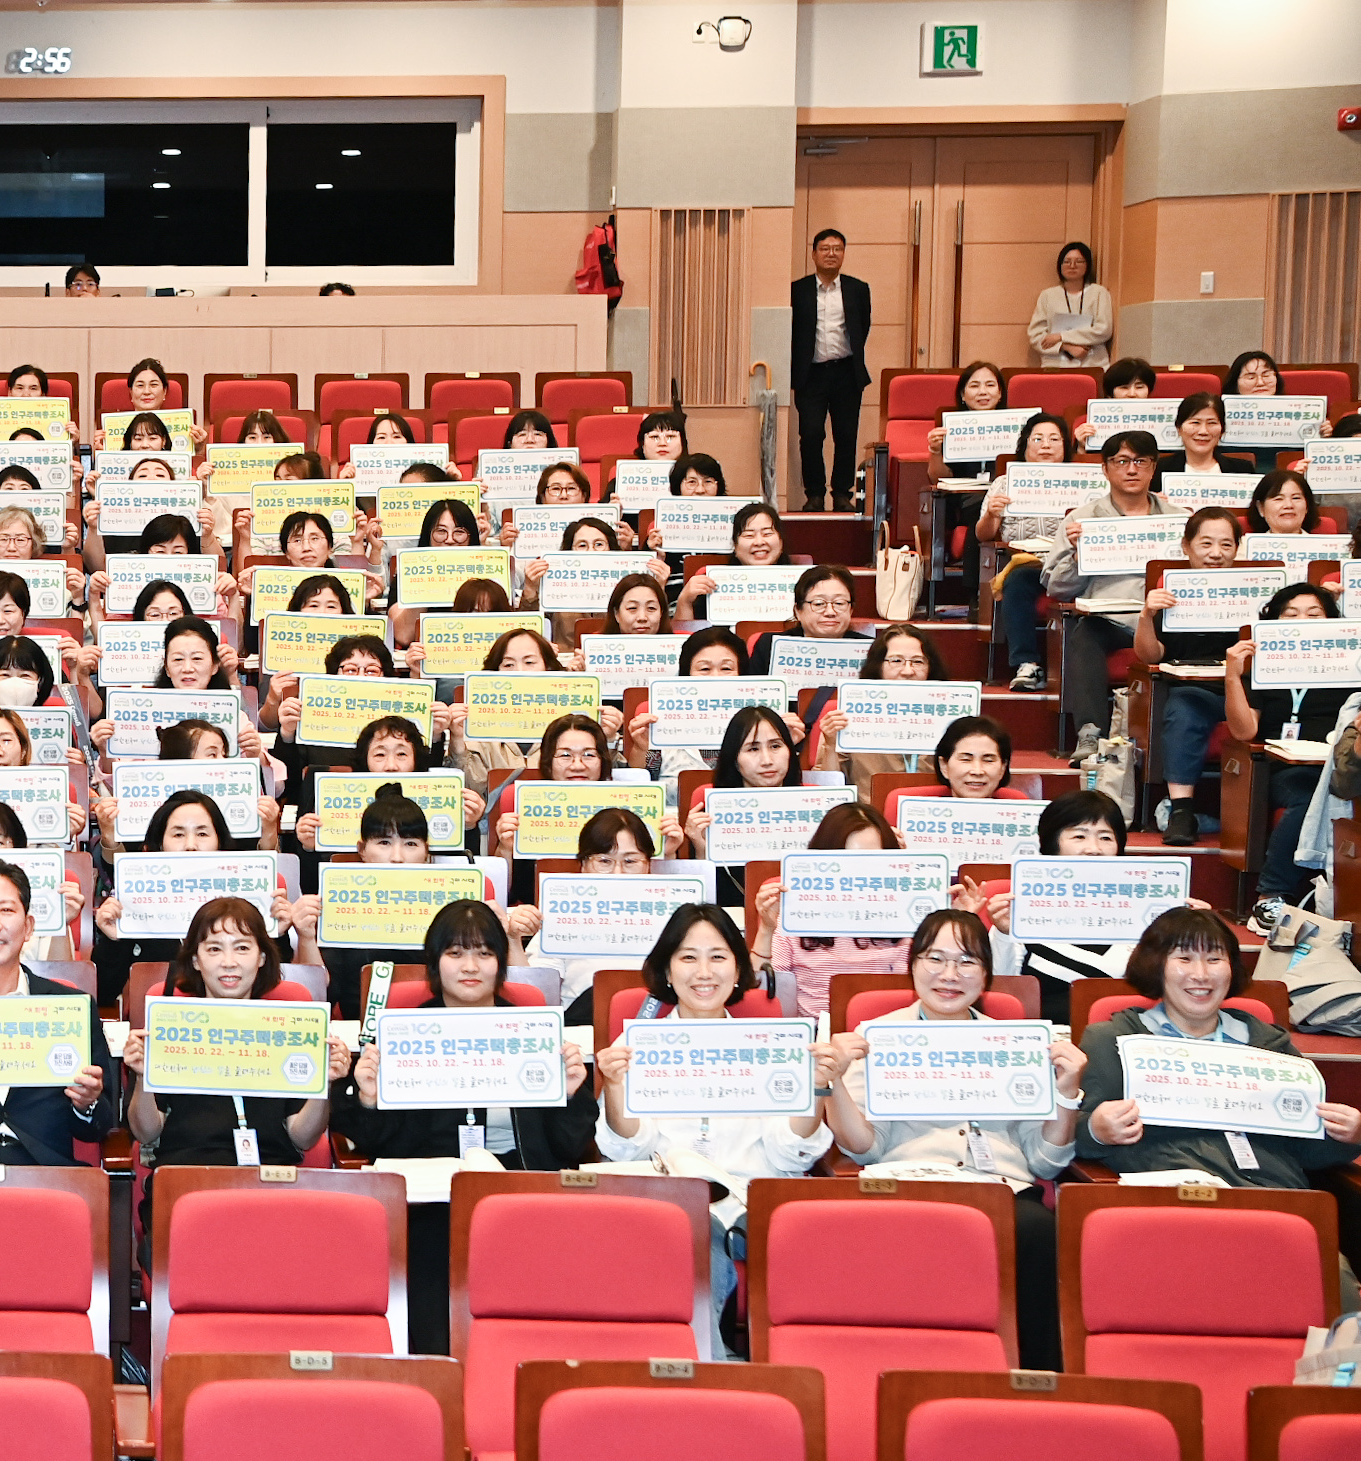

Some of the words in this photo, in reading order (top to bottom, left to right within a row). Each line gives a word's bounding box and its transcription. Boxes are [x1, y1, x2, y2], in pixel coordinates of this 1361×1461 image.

[20, 47, 71, 72] 2:56
[11, 411, 64, 419] 인구주택총조사
[1257, 411, 1320, 420] 인구주택총조사
[950, 427, 974, 435] 2025
[1312, 456, 1340, 464] 2025
[1013, 479, 1040, 487] 2025
[1044, 480, 1107, 489] 인구주택총조사
[103, 498, 130, 506] 2025
[133, 497, 196, 507] 인구주택총조사
[257, 498, 283, 507] 2025
[286, 497, 350, 507] 인구주택총조사
[661, 514, 689, 522] 2025
[1084, 535, 1113, 544] 2025
[404, 566, 433, 575] 2025
[547, 569, 576, 579] 2025
[113, 573, 141, 582] 2025
[1171, 589, 1203, 598] 2025
[1260, 641, 1296, 651] 2025
[62, 686, 74, 705] 2025
[472, 694, 507, 704] 2025
[511, 694, 593, 706] 인구주택총조사
[307, 696, 341, 708] 2025
[657, 699, 693, 710] 2025
[114, 710, 148, 721] 2025
[846, 703, 882, 714] 2025
[887, 703, 972, 717] 인구주택총조사
[524, 805, 561, 817] 2025
[715, 812, 753, 824] 2025
[907, 820, 946, 833] 2025
[125, 880, 166, 893] 2025
[791, 877, 834, 890] 2025
[840, 877, 941, 891] 인구주택총조사
[329, 890, 370, 903] 2025
[1022, 883, 1066, 896] 2025
[1072, 883, 1179, 898] 인구주택총조사
[549, 901, 591, 913] 2025
[642, 997, 658, 1018] 202
[155, 1027, 202, 1042] 2025
[208, 1029, 319, 1047] 인구주택총조사
[388, 1040, 435, 1055] 2025
[441, 1038, 554, 1055] 인구주택총조사
[635, 1050, 683, 1065] 2025
[689, 1048, 804, 1065] 인구주택총조사
[874, 1052, 922, 1066] 2025
[928, 1050, 1043, 1067] 인구주택총조사
[1134, 1058, 1185, 1072] 2025
[1191, 1061, 1312, 1085] 인구주택총조사
[1183, 1189, 1211, 1197] B-E-2
